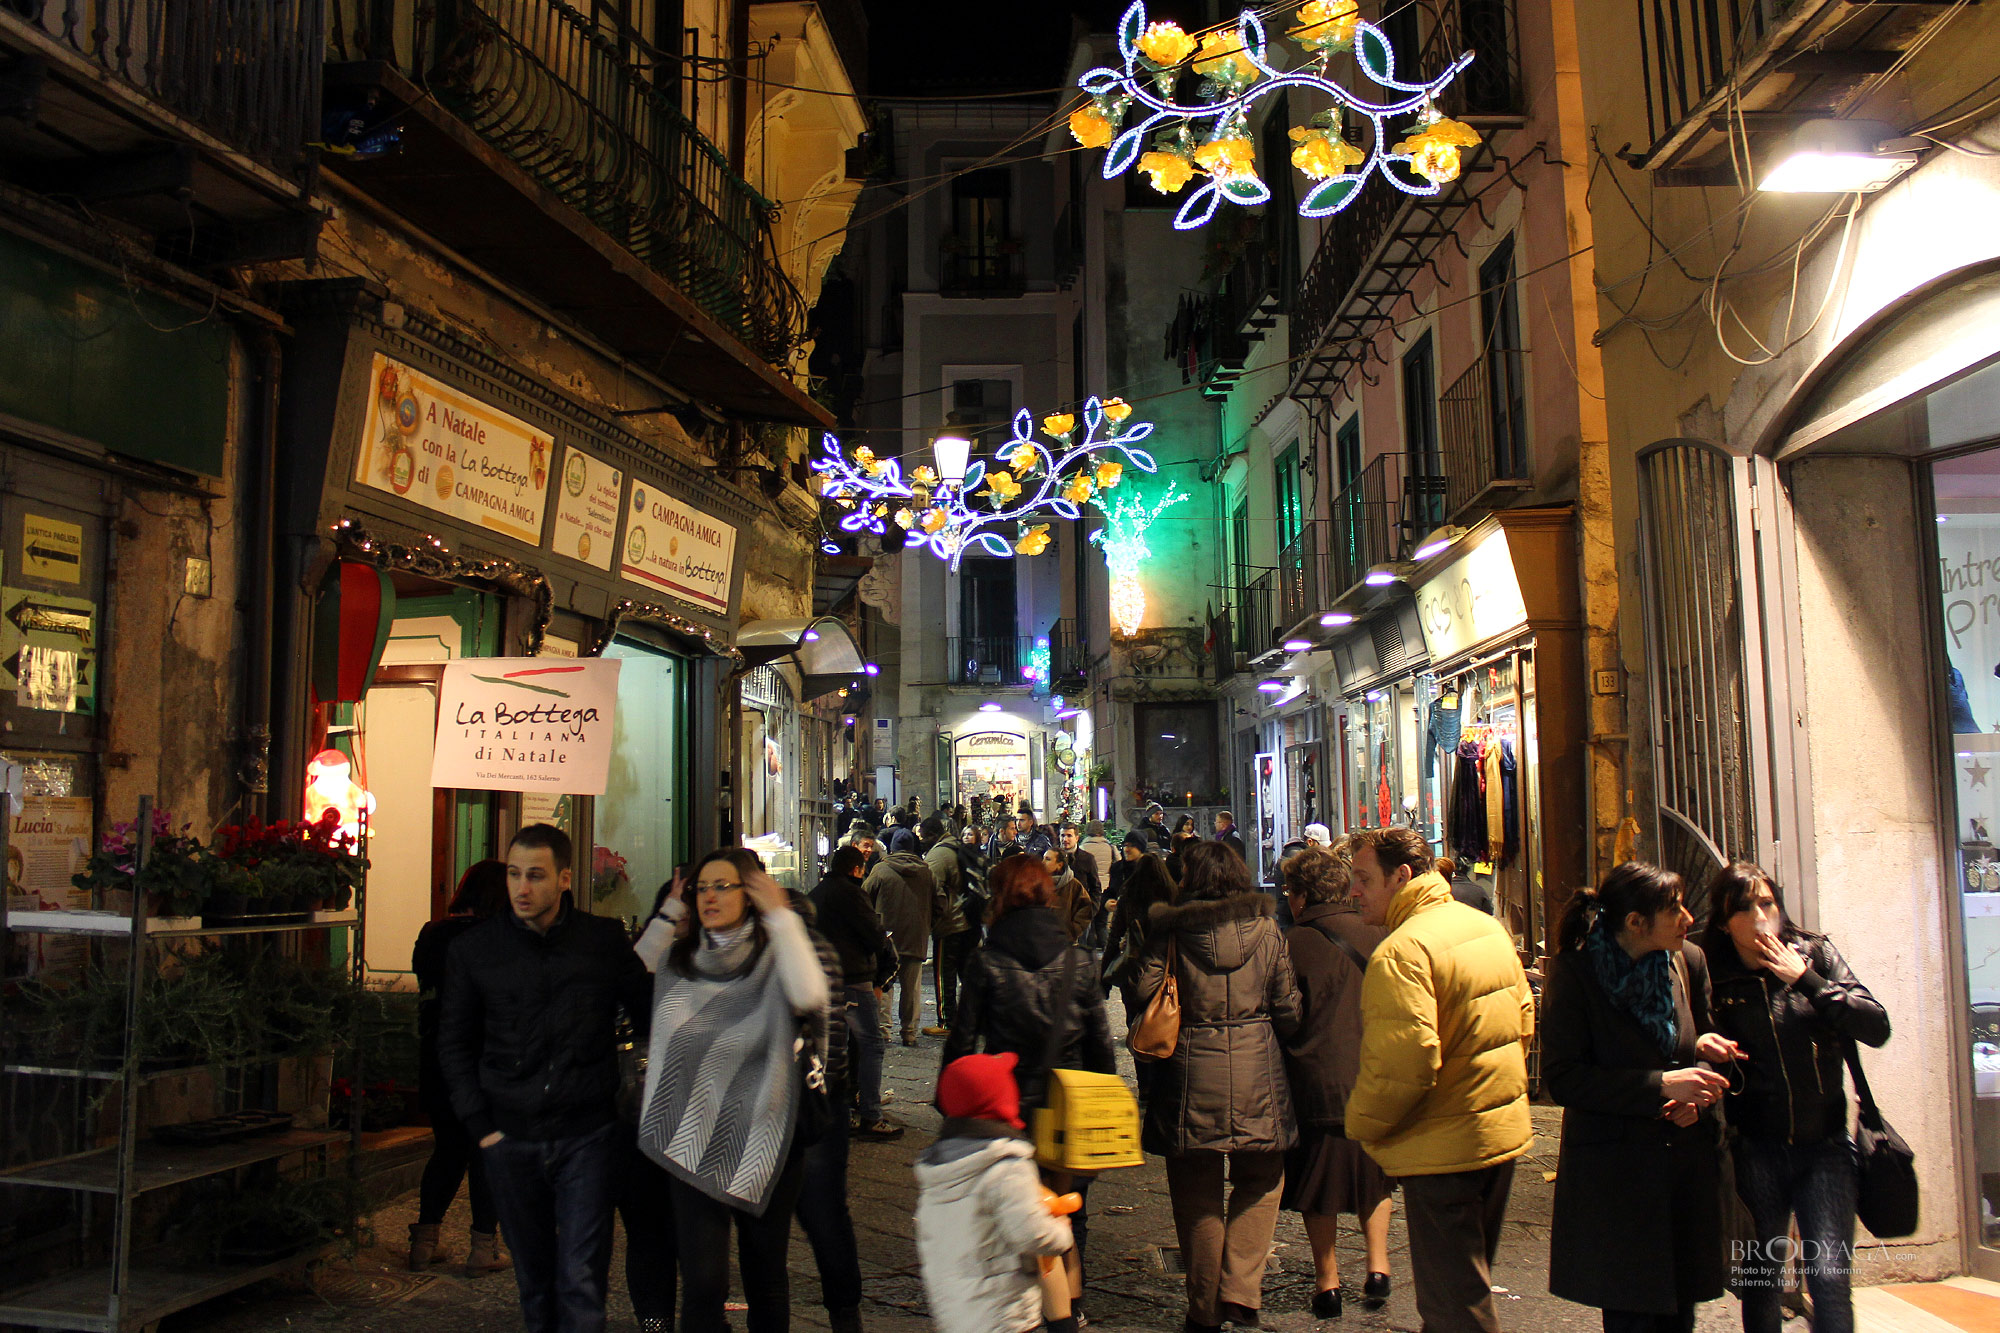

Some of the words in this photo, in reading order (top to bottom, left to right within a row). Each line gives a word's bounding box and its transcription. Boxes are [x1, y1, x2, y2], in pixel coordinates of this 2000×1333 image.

[426, 401, 437, 425] A
[442, 407, 487, 446] Natale
[422, 438, 443, 459] con
[445, 443, 457, 464] la
[460, 448, 478, 473] La
[480, 455, 529, 498] Bottega
[417, 465, 430, 485] di
[455, 481, 508, 515] CAMPAGNA
[508, 502, 535, 526] AMICA
[651, 502, 696, 537] CAMPAGNA
[695, 523, 722, 549] AMICA
[658, 556, 678, 572] natura
[678, 560, 685, 575] in
[684, 555, 726, 596] Bottega
[456, 702, 486, 726] La
[494, 702, 600, 736] Bottega
[464, 729, 586, 743] ITALIANA
[474, 747, 493, 761] di
[502, 747, 568, 764] Natale
[968, 734, 1015, 747] Ceramica
[475, 771, 486, 779] Via
[486, 772, 497, 780] Dei
[498, 772, 525, 781] Mercanti,
[526, 773, 537, 781] 162
[538, 774, 561, 782] Salerno
[14, 816, 53, 835] Lucia
